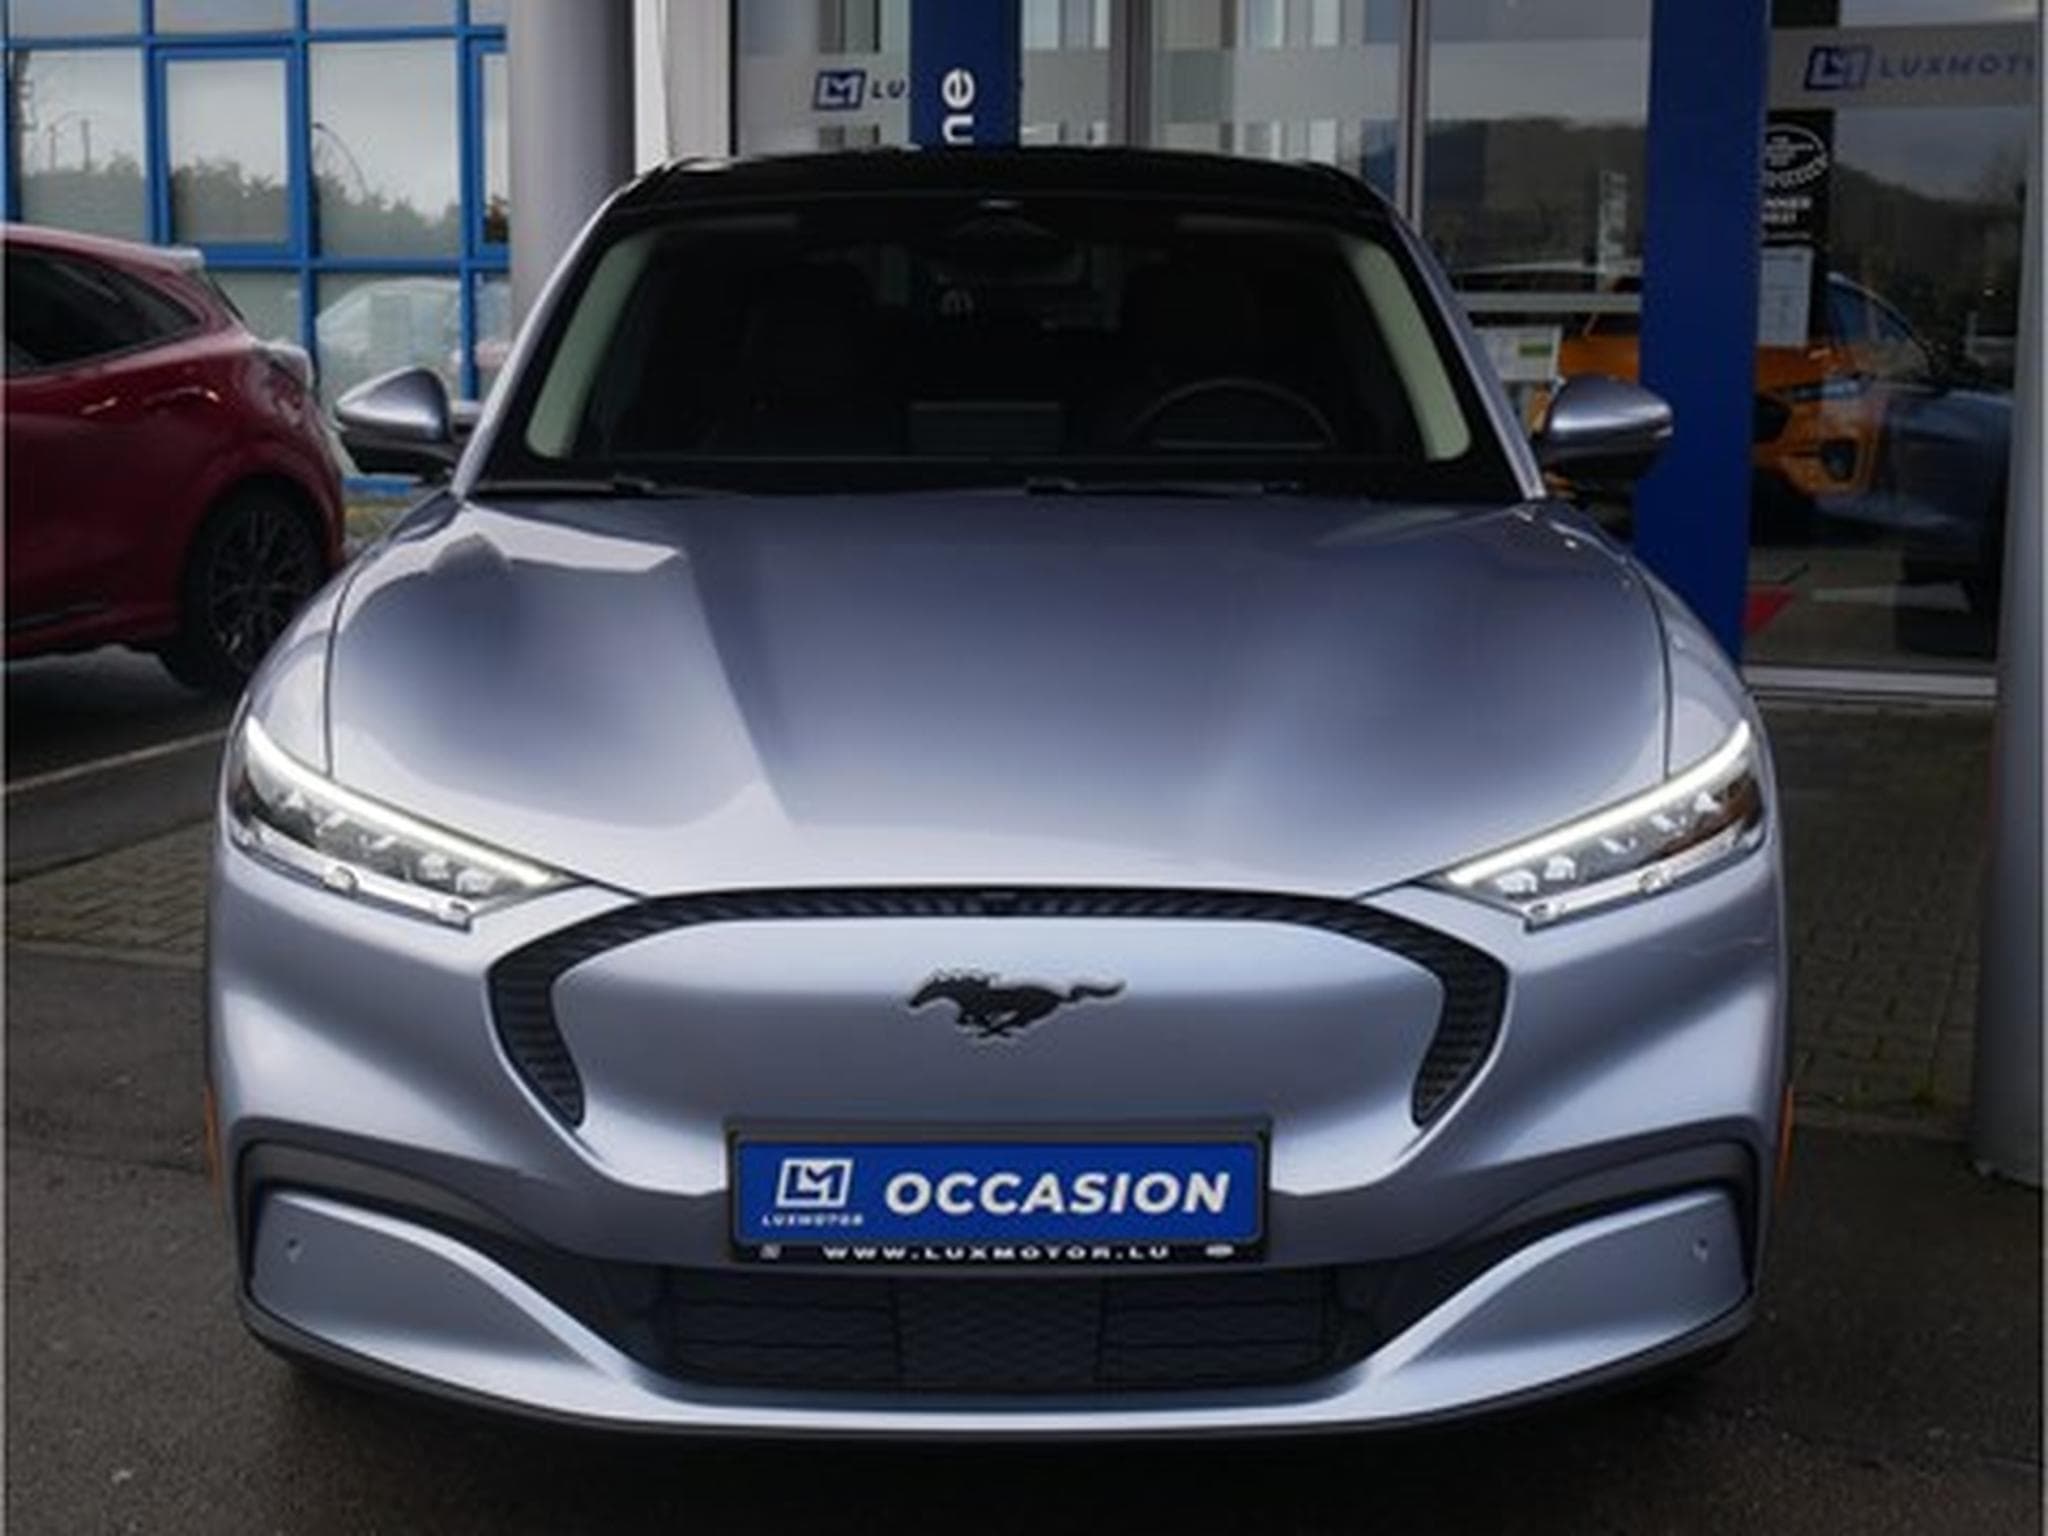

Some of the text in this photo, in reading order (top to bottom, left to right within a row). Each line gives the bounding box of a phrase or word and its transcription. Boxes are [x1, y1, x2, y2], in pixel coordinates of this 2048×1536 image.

[885, 1172, 1230, 1215] OCCASION
[761, 1214, 864, 1226] LUXMOTOR
[822, 1246, 1169, 1260] WWW.LUXMOTOR.LU
